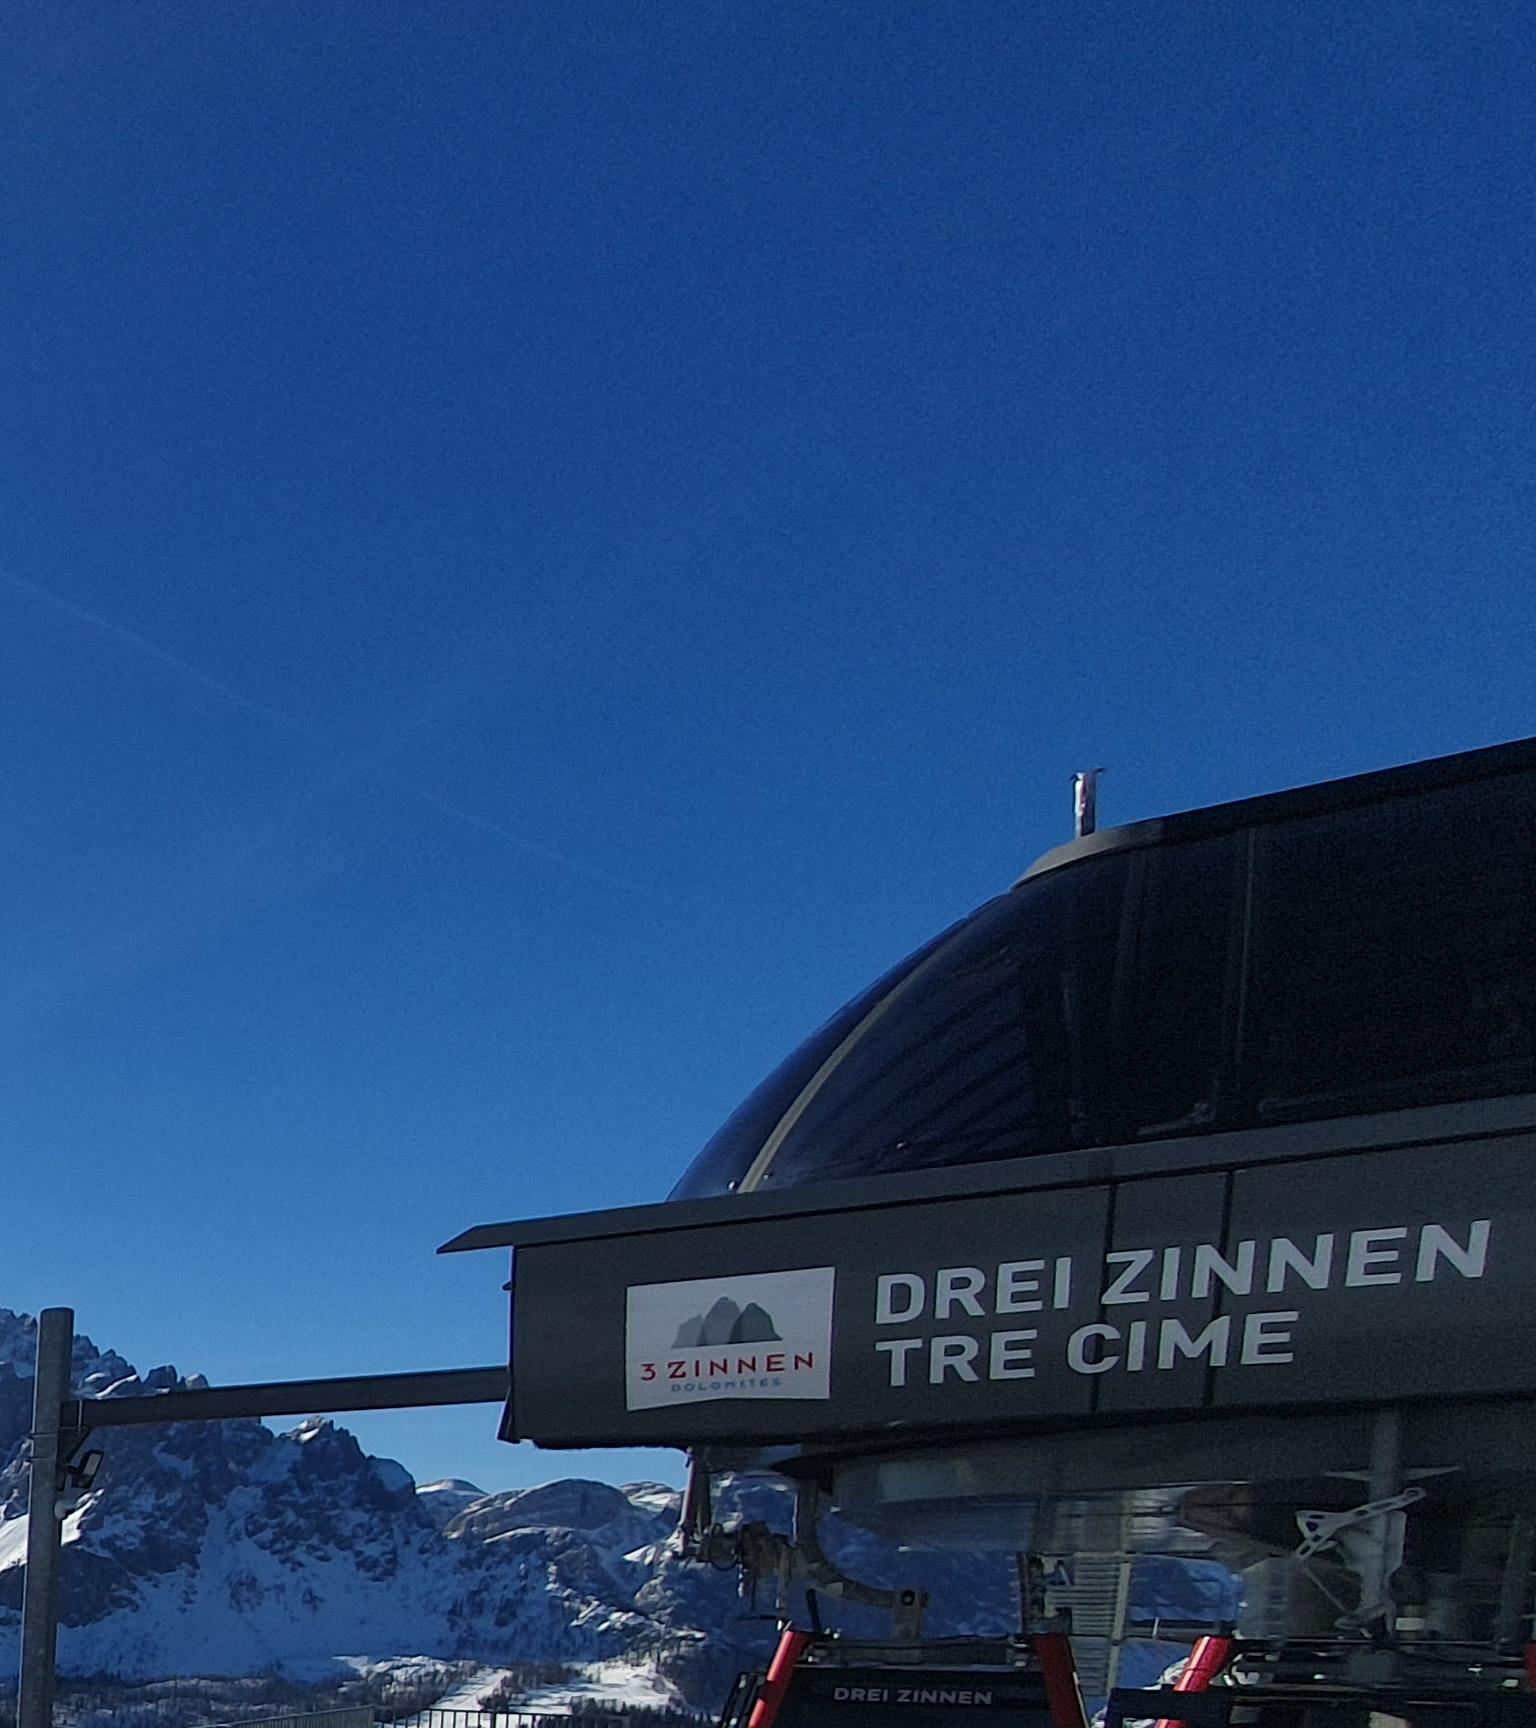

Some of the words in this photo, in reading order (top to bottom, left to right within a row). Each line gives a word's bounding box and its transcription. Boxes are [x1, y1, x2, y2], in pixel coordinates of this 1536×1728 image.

[874, 1257, 1071, 1325] DREI
[1102, 1219, 1491, 1306] ZINNEN
[875, 1329, 1039, 1387] TRE
[1067, 1311, 1300, 1374] CIME
[640, 1362, 657, 1381] 3
[667, 1351, 814, 1380] ZINNEN
[671, 1377, 783, 1392] DOLOMITES
[833, 1687, 889, 1701] DREI
[896, 1689, 993, 1705] ZINNEN
